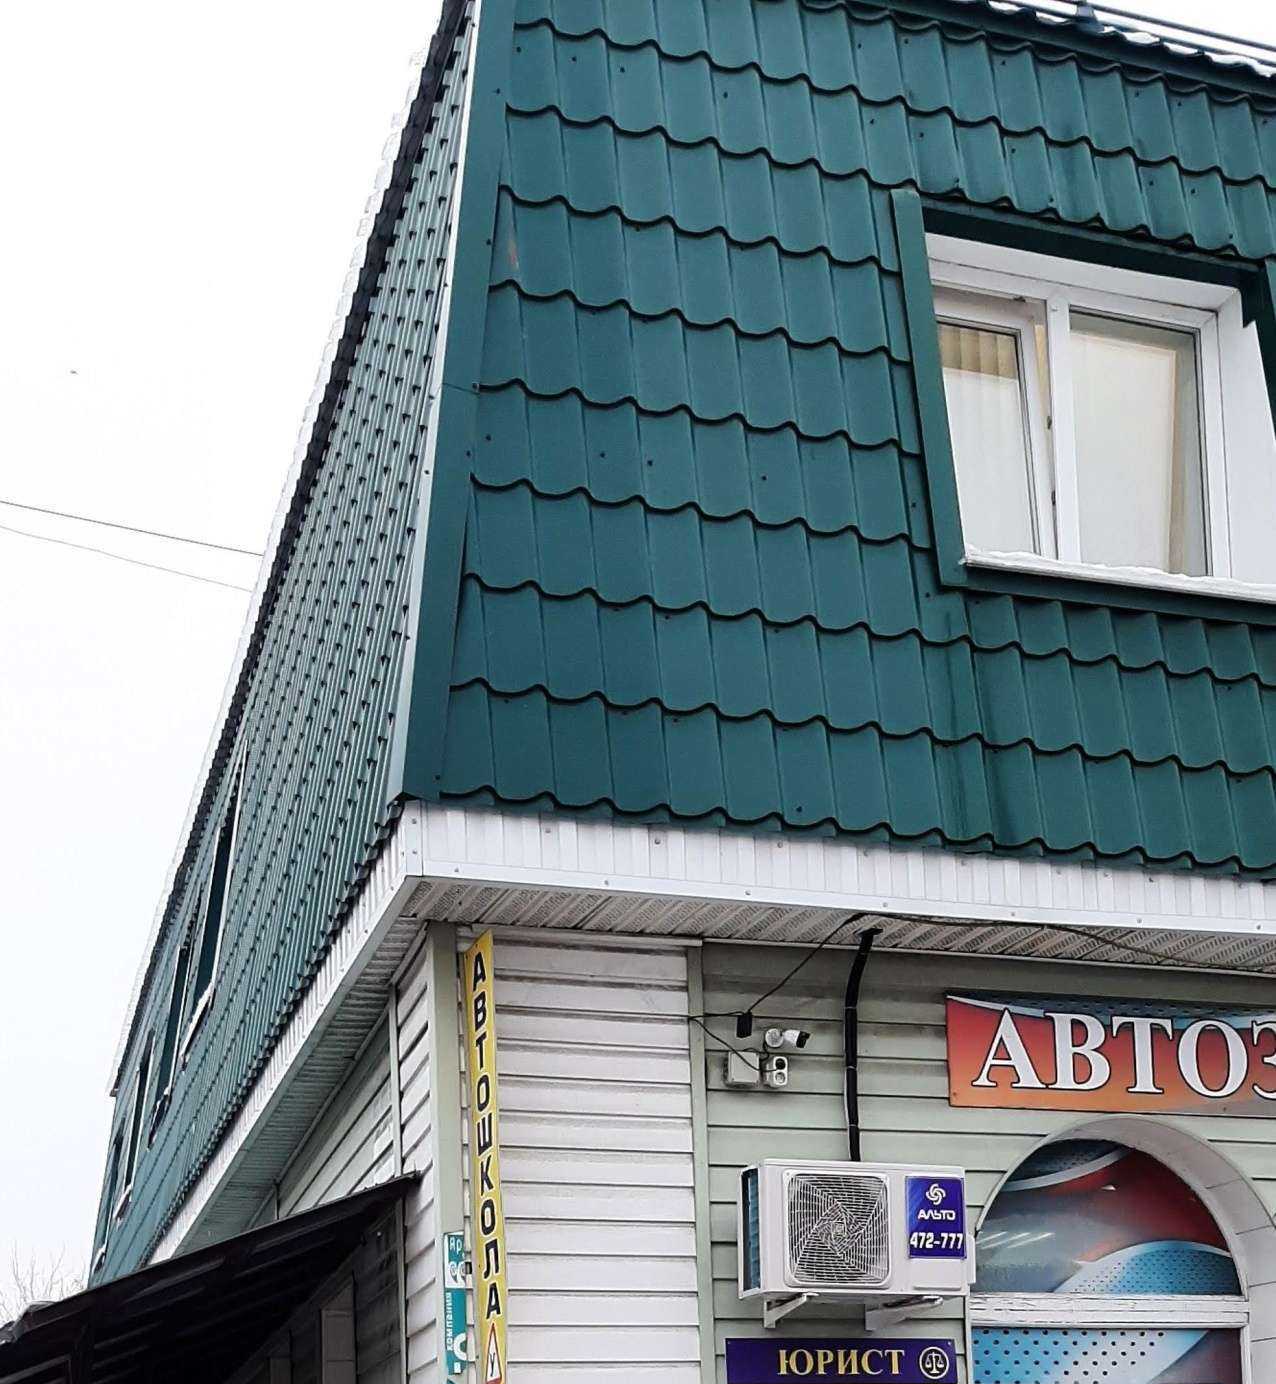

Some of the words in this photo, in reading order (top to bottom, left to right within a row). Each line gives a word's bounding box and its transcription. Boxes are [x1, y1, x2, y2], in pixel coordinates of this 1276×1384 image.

[473, 951, 501, 1319] АВТОШКОЛА
[910, 1232, 963, 1249] 472-777
[777, 1349, 905, 1376] ЮРИСТ
